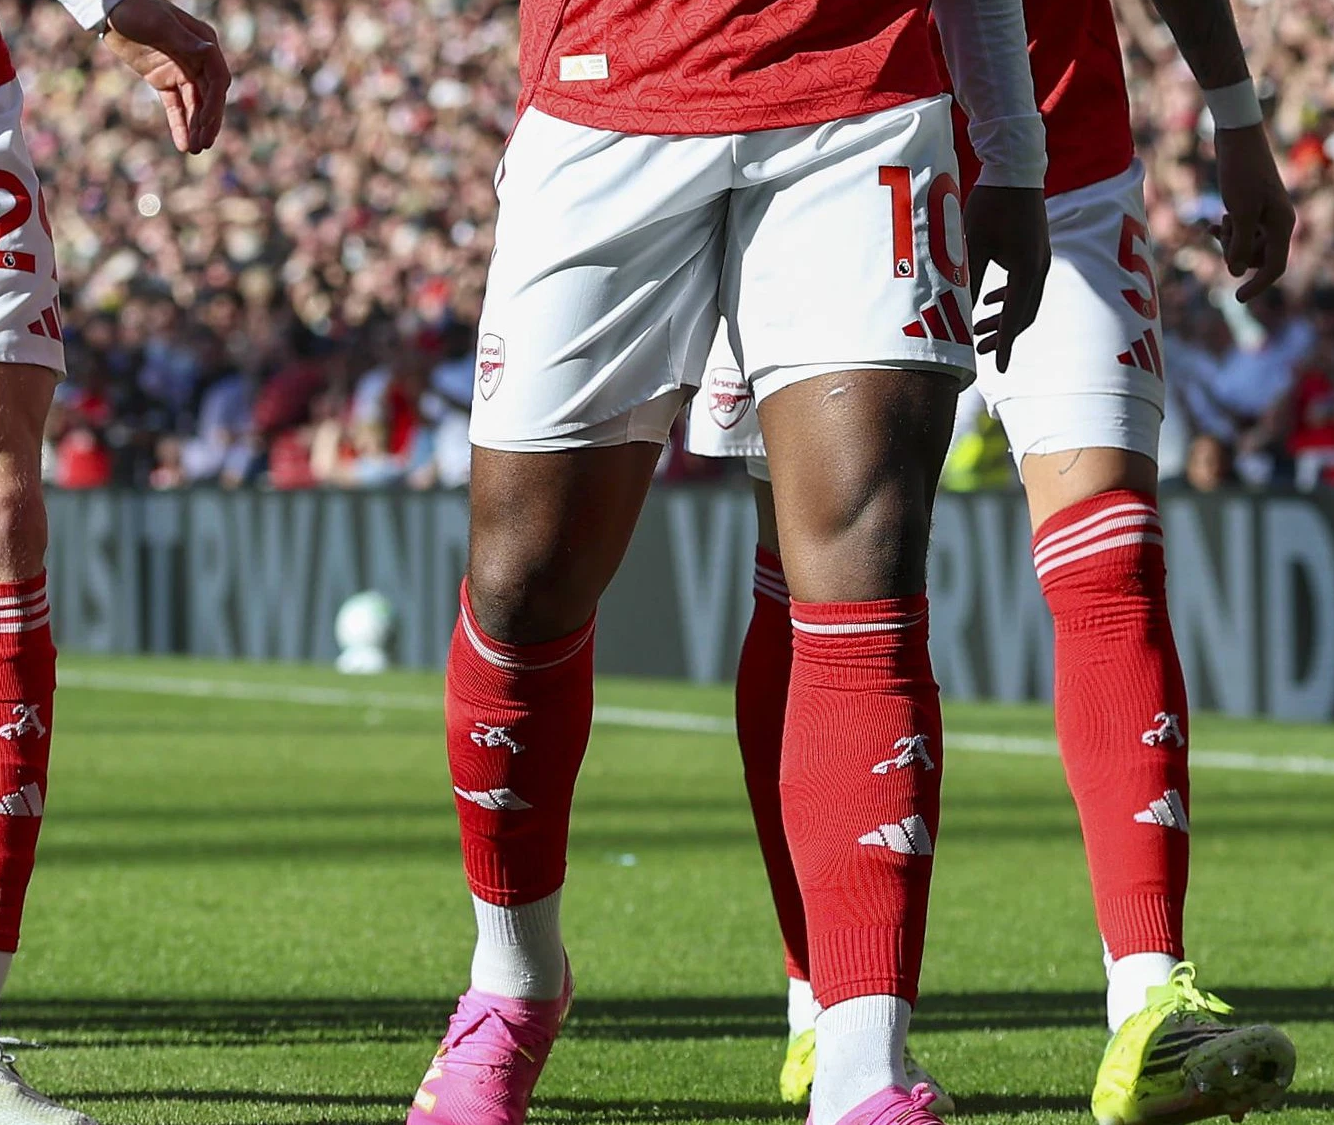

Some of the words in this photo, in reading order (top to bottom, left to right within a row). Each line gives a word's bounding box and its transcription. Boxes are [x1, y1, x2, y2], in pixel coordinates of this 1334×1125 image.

[878, 166, 968, 286] 10
[1117, 214, 1158, 320] 5
[712, 378, 747, 389] Arsena
